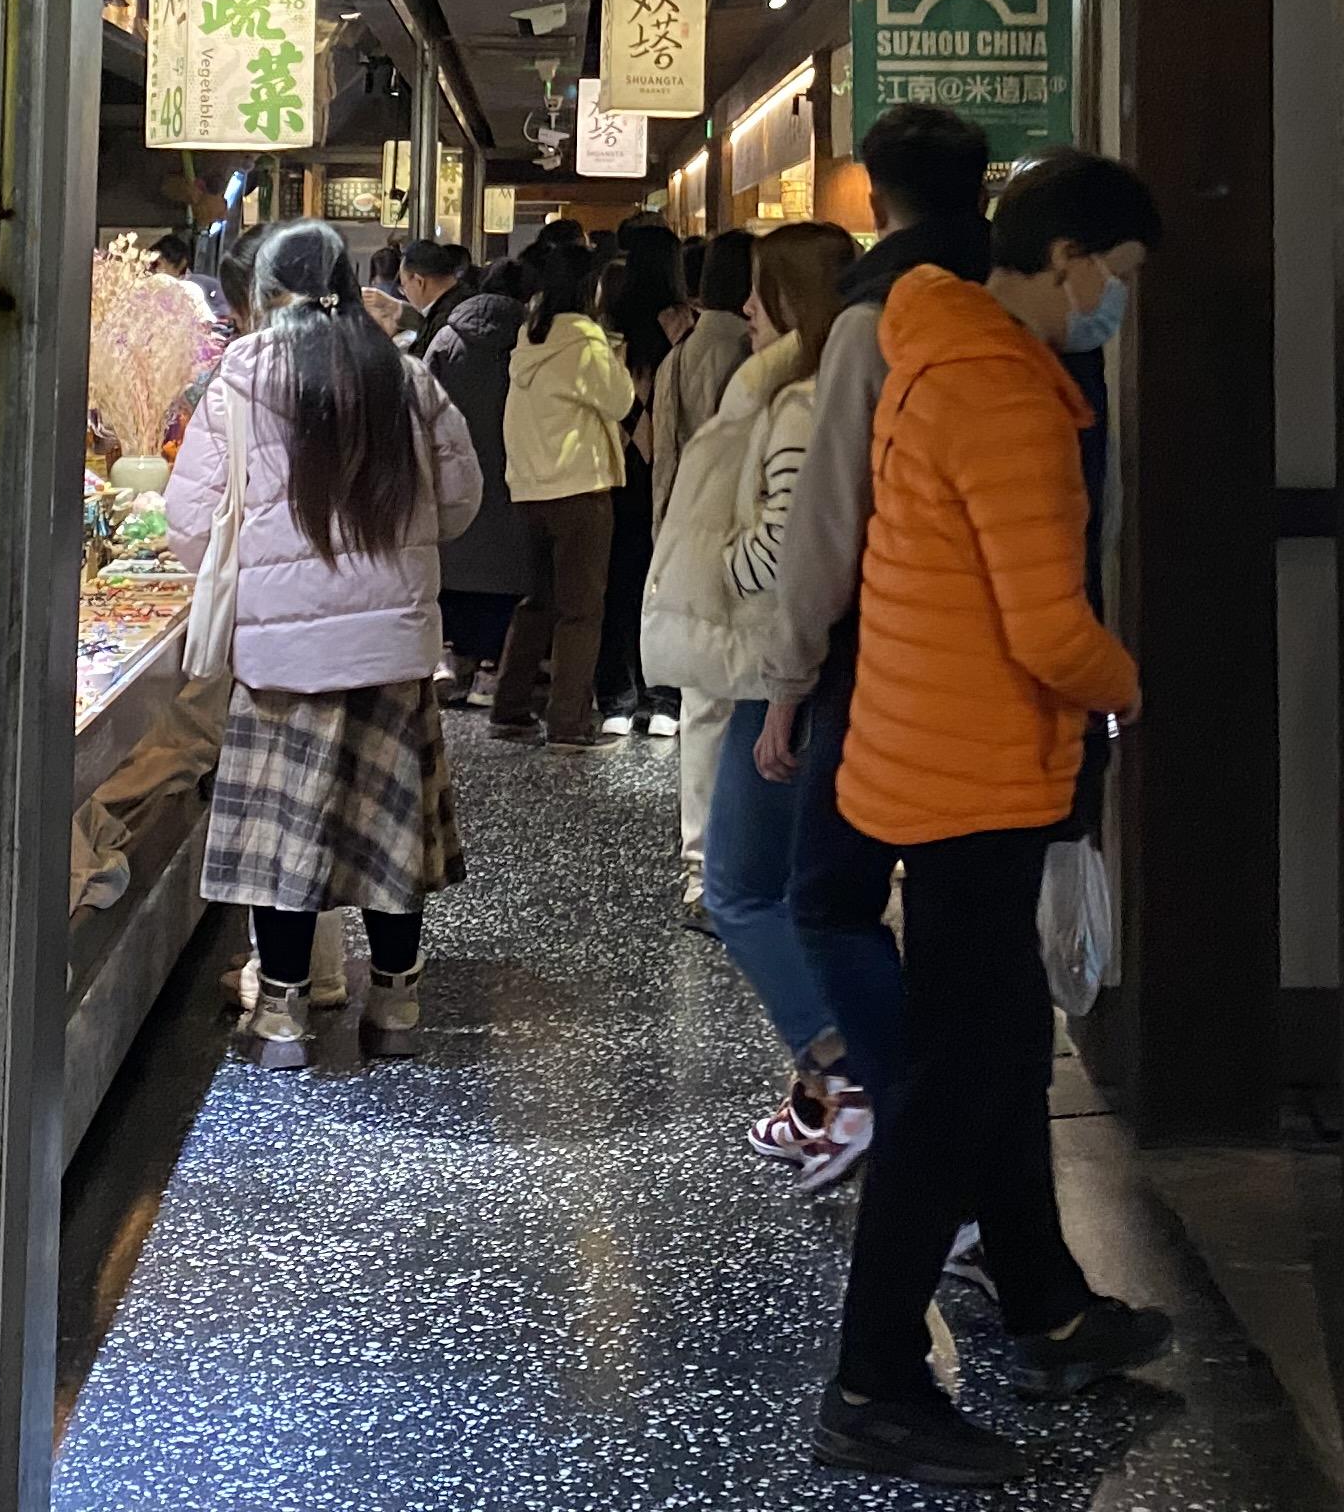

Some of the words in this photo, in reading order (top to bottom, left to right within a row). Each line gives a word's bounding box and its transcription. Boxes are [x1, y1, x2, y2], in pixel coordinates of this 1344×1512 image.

[877, 30, 970, 57] SUZHOU
[977, 30, 1048, 57] CHINA
[199, 48, 215, 136] Vegetables
[626, 75, 685, 86] SHUANGTA
